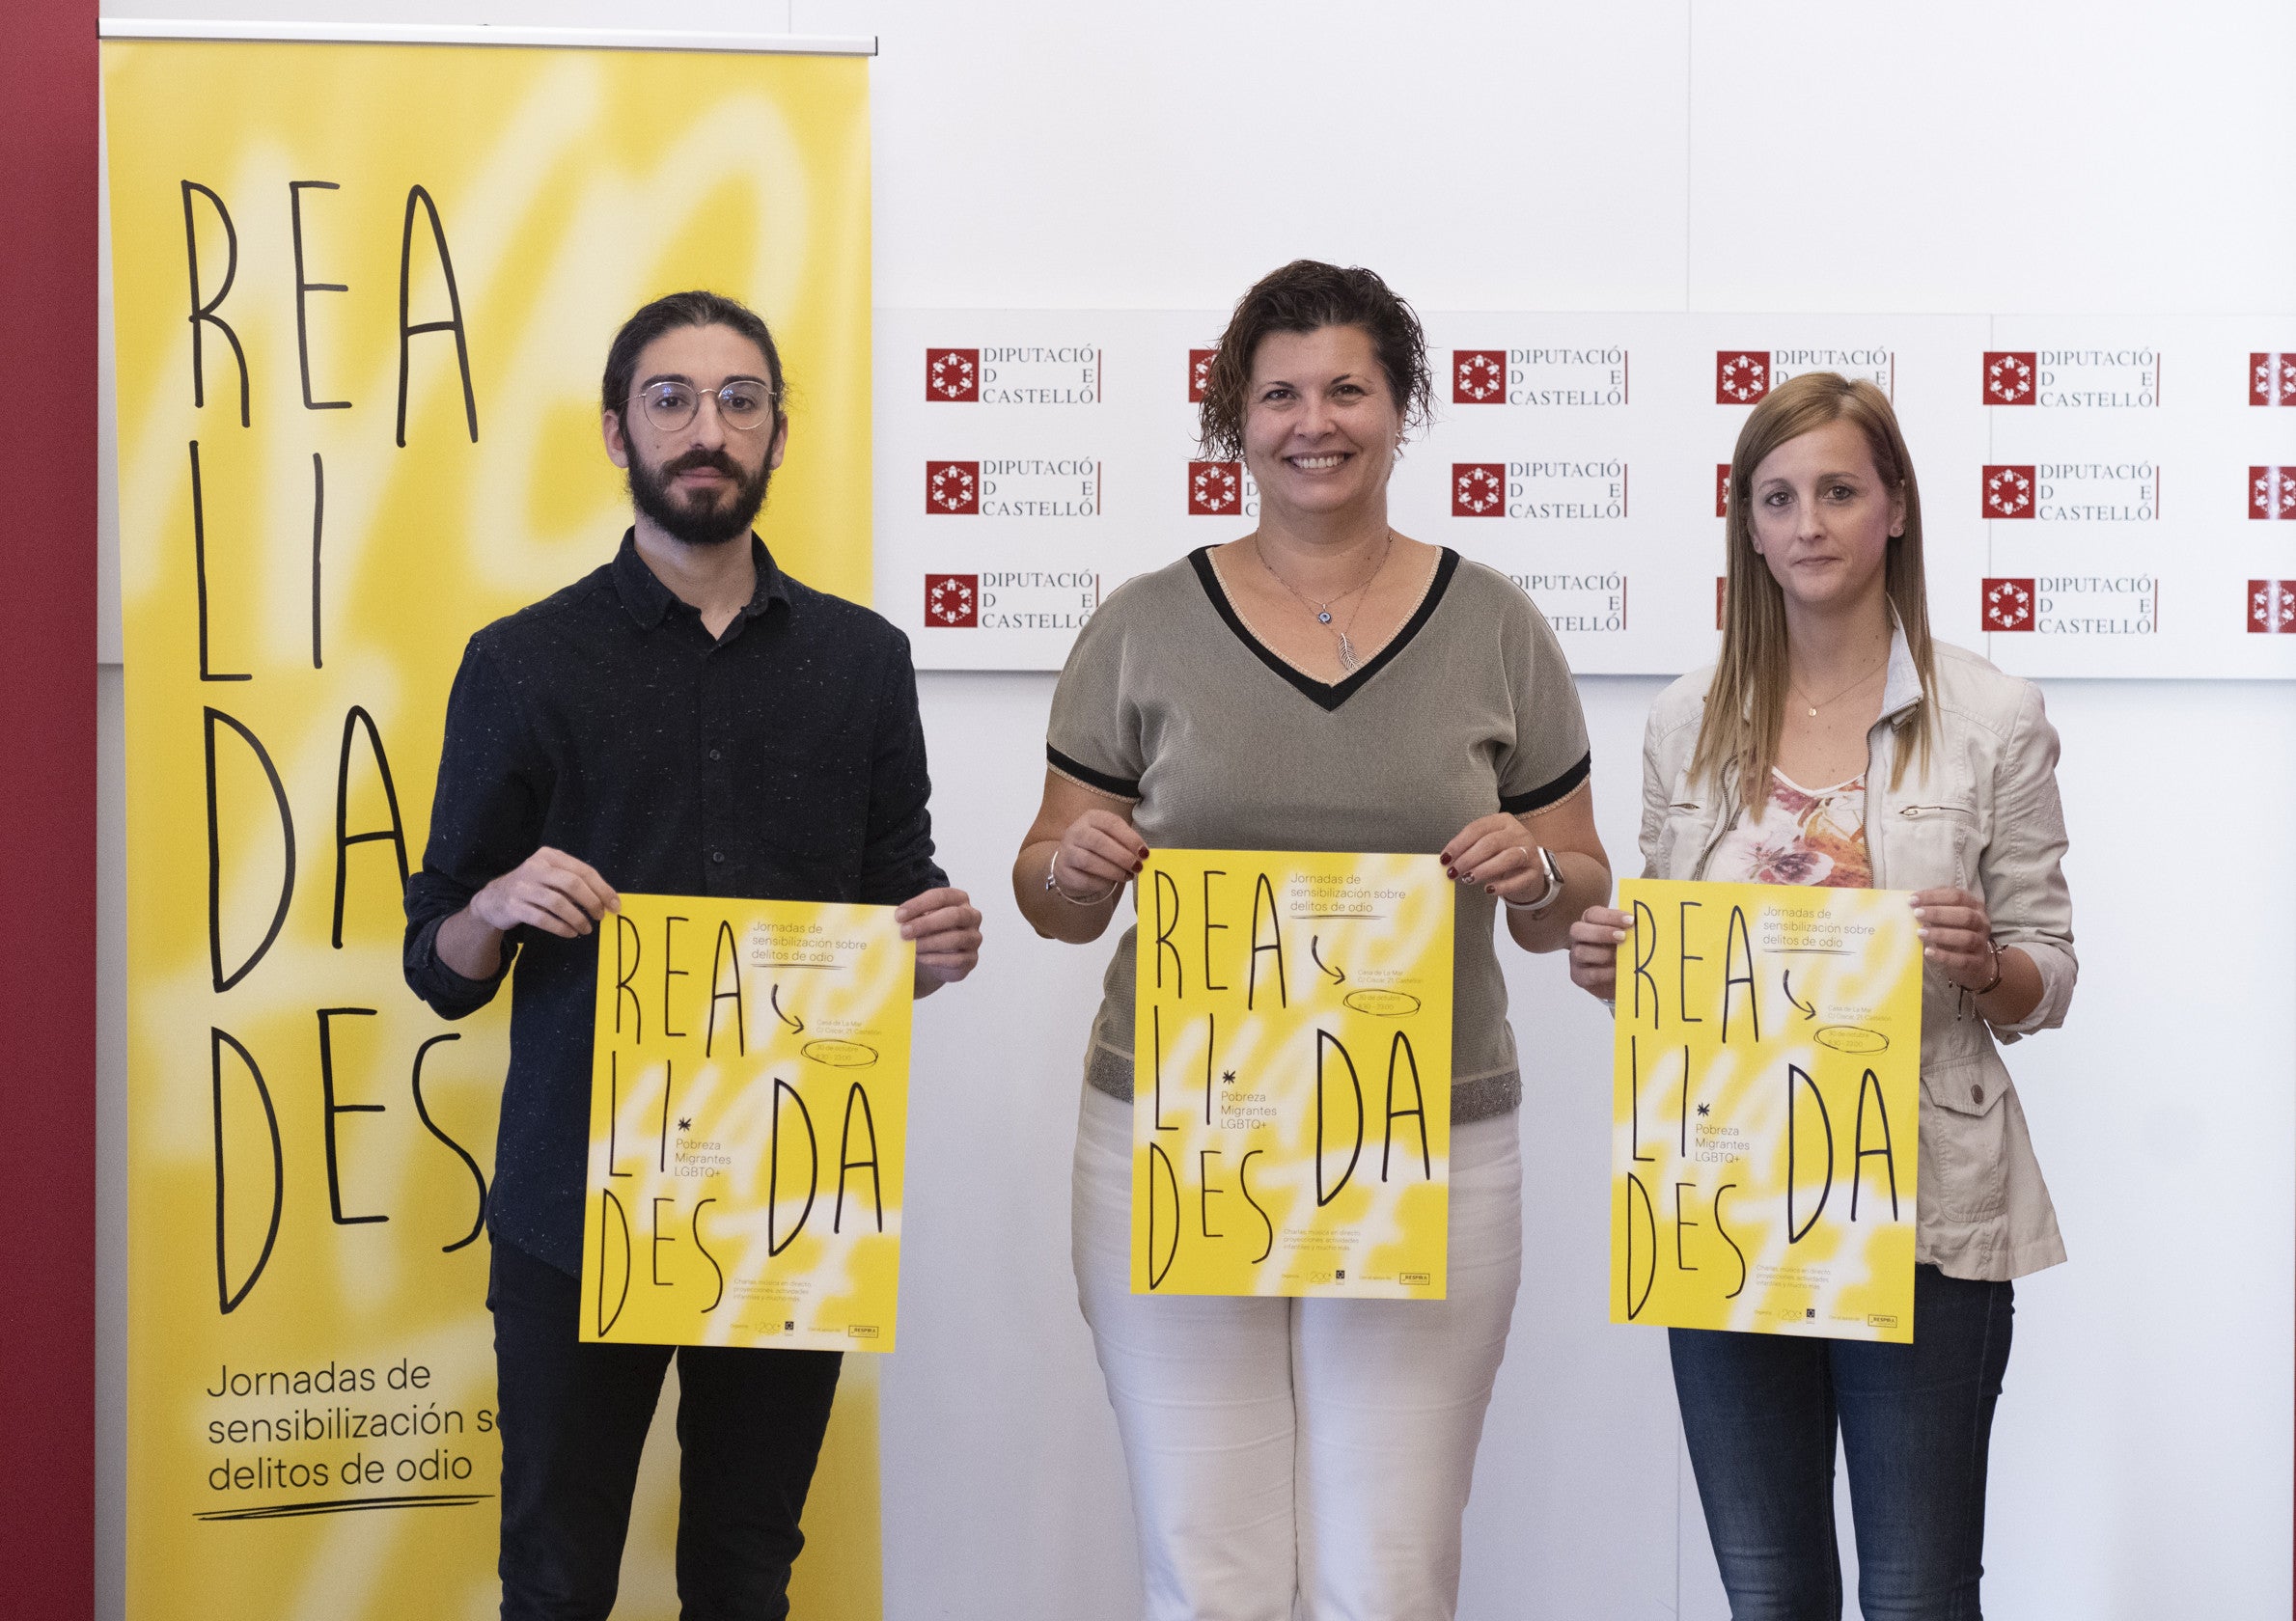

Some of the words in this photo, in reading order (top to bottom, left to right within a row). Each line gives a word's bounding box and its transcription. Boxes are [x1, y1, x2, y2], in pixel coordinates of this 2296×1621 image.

[983, 343, 1093, 363] DIPUTACIÓ
[1511, 345, 1621, 365] DIPUTACIÓ
[1776, 347, 1887, 366] DIPUTACIÓ
[2040, 347, 2152, 366] DIPUTACIÓ
[983, 369, 997, 382] D
[1083, 369, 1093, 383] E
[1510, 371, 1524, 384] D
[1611, 371, 1621, 385] E
[2041, 371, 2055, 386] D
[2142, 371, 2152, 387] E
[982, 385, 1093, 403] CASTELLÓ
[1509, 387, 1621, 405] CASTELLÓ
[2040, 389, 2152, 407] CASTELLÓ
[983, 456, 1093, 476] DIPUTACIÓ
[1510, 458, 1620, 478] DIPUTACIÓ
[2040, 460, 2152, 480] DIPUTACIÓ
[983, 481, 996, 495] D
[1082, 481, 1093, 496] E
[1510, 483, 1523, 497] D
[1610, 483, 1620, 498] E
[2040, 484, 2054, 500] D
[2141, 485, 2152, 500] E
[982, 498, 1093, 516] CASTELLÓ
[1509, 500, 1620, 518] CASTELLÓ
[2039, 502, 2151, 521] CASTELLÓ
[983, 568, 1093, 588] DIPUTACIÓ
[2039, 574, 2151, 592] DIPUTACIÓ
[982, 593, 996, 607] D
[1082, 593, 1093, 608] E
[2039, 597, 2053, 613] D
[2140, 599, 2151, 614] E
[1546, 613, 1620, 631] TELLÓ
[2038, 613, 2150, 634] CASTELLÓ
[1290, 873, 1342, 884] Jornadas
[1346, 875, 1361, 885] de
[1290, 887, 1371, 898] sensibilización
[1373, 889, 1406, 899] sobre
[1290, 900, 1327, 911] delitos
[1331, 901, 1345, 912] de
[1348, 902, 1372, 912] odio
[1763, 907, 1814, 918] Jornadas
[1817, 909, 1831, 919] de
[753, 921, 805, 933] Jornadas
[808, 923, 822, 934] de
[1763, 920, 1840, 933] sensibilización
[1844, 924, 1875, 935] sobre
[753, 936, 832, 948] sensibilización
[836, 940, 867, 950] sobre
[1762, 934, 1799, 946] delitos
[1802, 936, 1815, 947] de
[1818, 937, 1843, 948] odio
[752, 949, 788, 961] delitos
[791, 950, 806, 961] de
[810, 952, 834, 963] odio
[1221, 1090, 1266, 1102] Pobreza
[1221, 1105, 1277, 1117] Migrantes
[1221, 1119, 1266, 1129] LGBTQ+
[1696, 1123, 1739, 1136] Pobreza
[677, 1139, 721, 1150] Pobreza
[1695, 1138, 1750, 1150] Migrantes
[676, 1153, 732, 1166] Migrantes
[1695, 1151, 1740, 1163] LGBTQ+
[674, 1167, 720, 1177] LGBTQ+
[207, 1360, 375, 1397] Jornadas
[387, 1358, 430, 1389] de
[208, 1402, 463, 1443] sensibilización
[208, 1458, 329, 1490] delitos
[341, 1452, 385, 1485] de
[397, 1448, 472, 1481] odio
